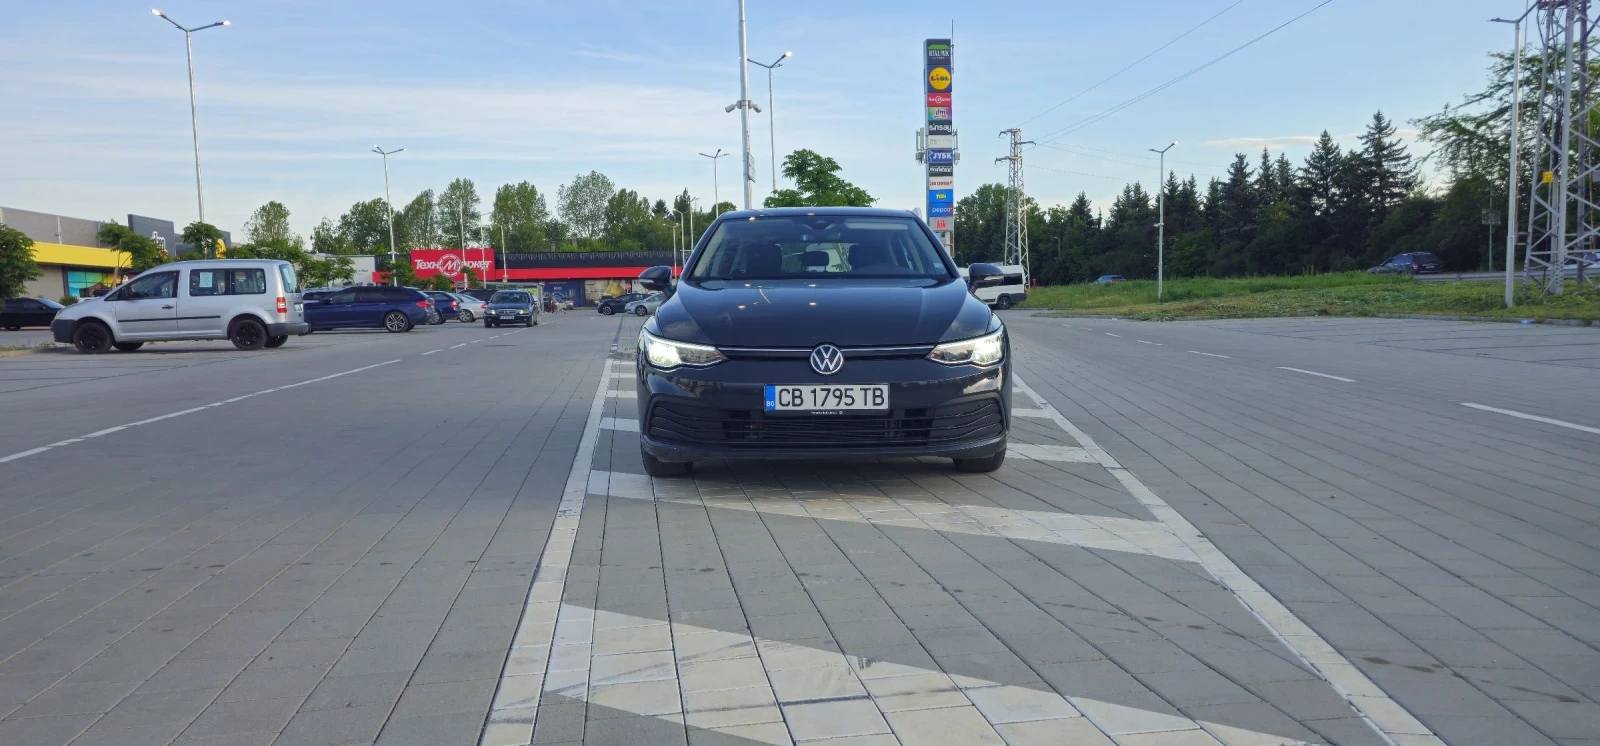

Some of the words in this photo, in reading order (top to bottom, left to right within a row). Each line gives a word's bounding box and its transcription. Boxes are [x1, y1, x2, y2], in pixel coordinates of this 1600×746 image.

[929, 123, 952, 132] sinsay
[778, 388, 804, 407] CB
[810, 388, 856, 407] 1795
[860, 388, 885, 407] TB
